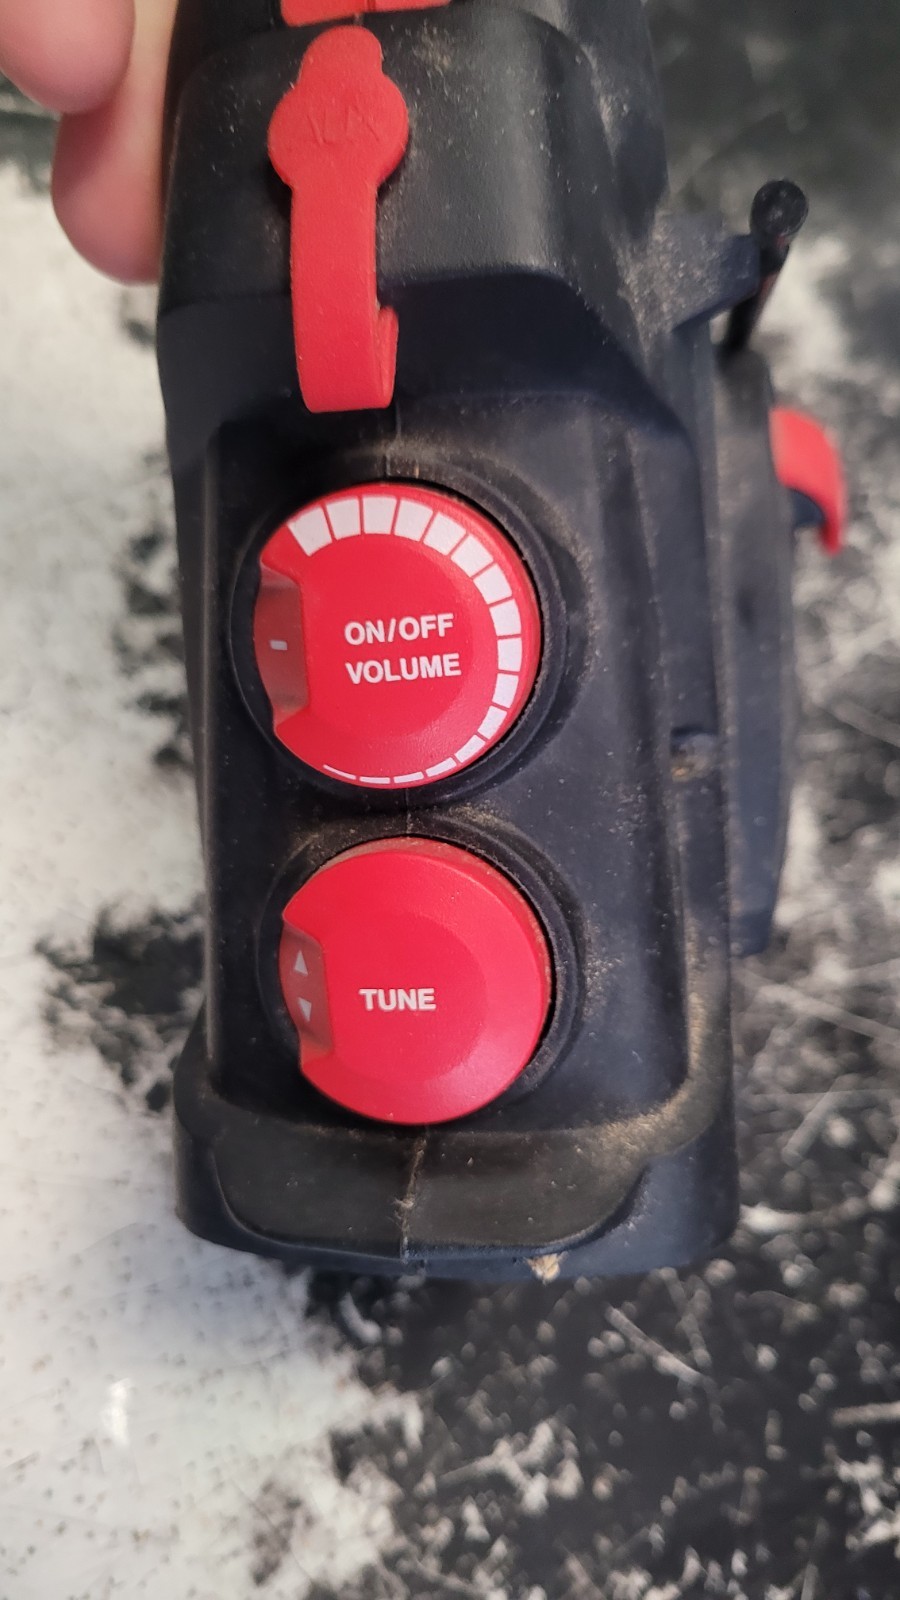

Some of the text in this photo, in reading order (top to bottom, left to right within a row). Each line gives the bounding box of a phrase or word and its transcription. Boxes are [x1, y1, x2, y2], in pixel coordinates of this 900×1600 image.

[344, 612, 454, 645] ON/OFF
[345, 652, 462, 685] VOLUME
[359, 987, 437, 1012] TUNE
